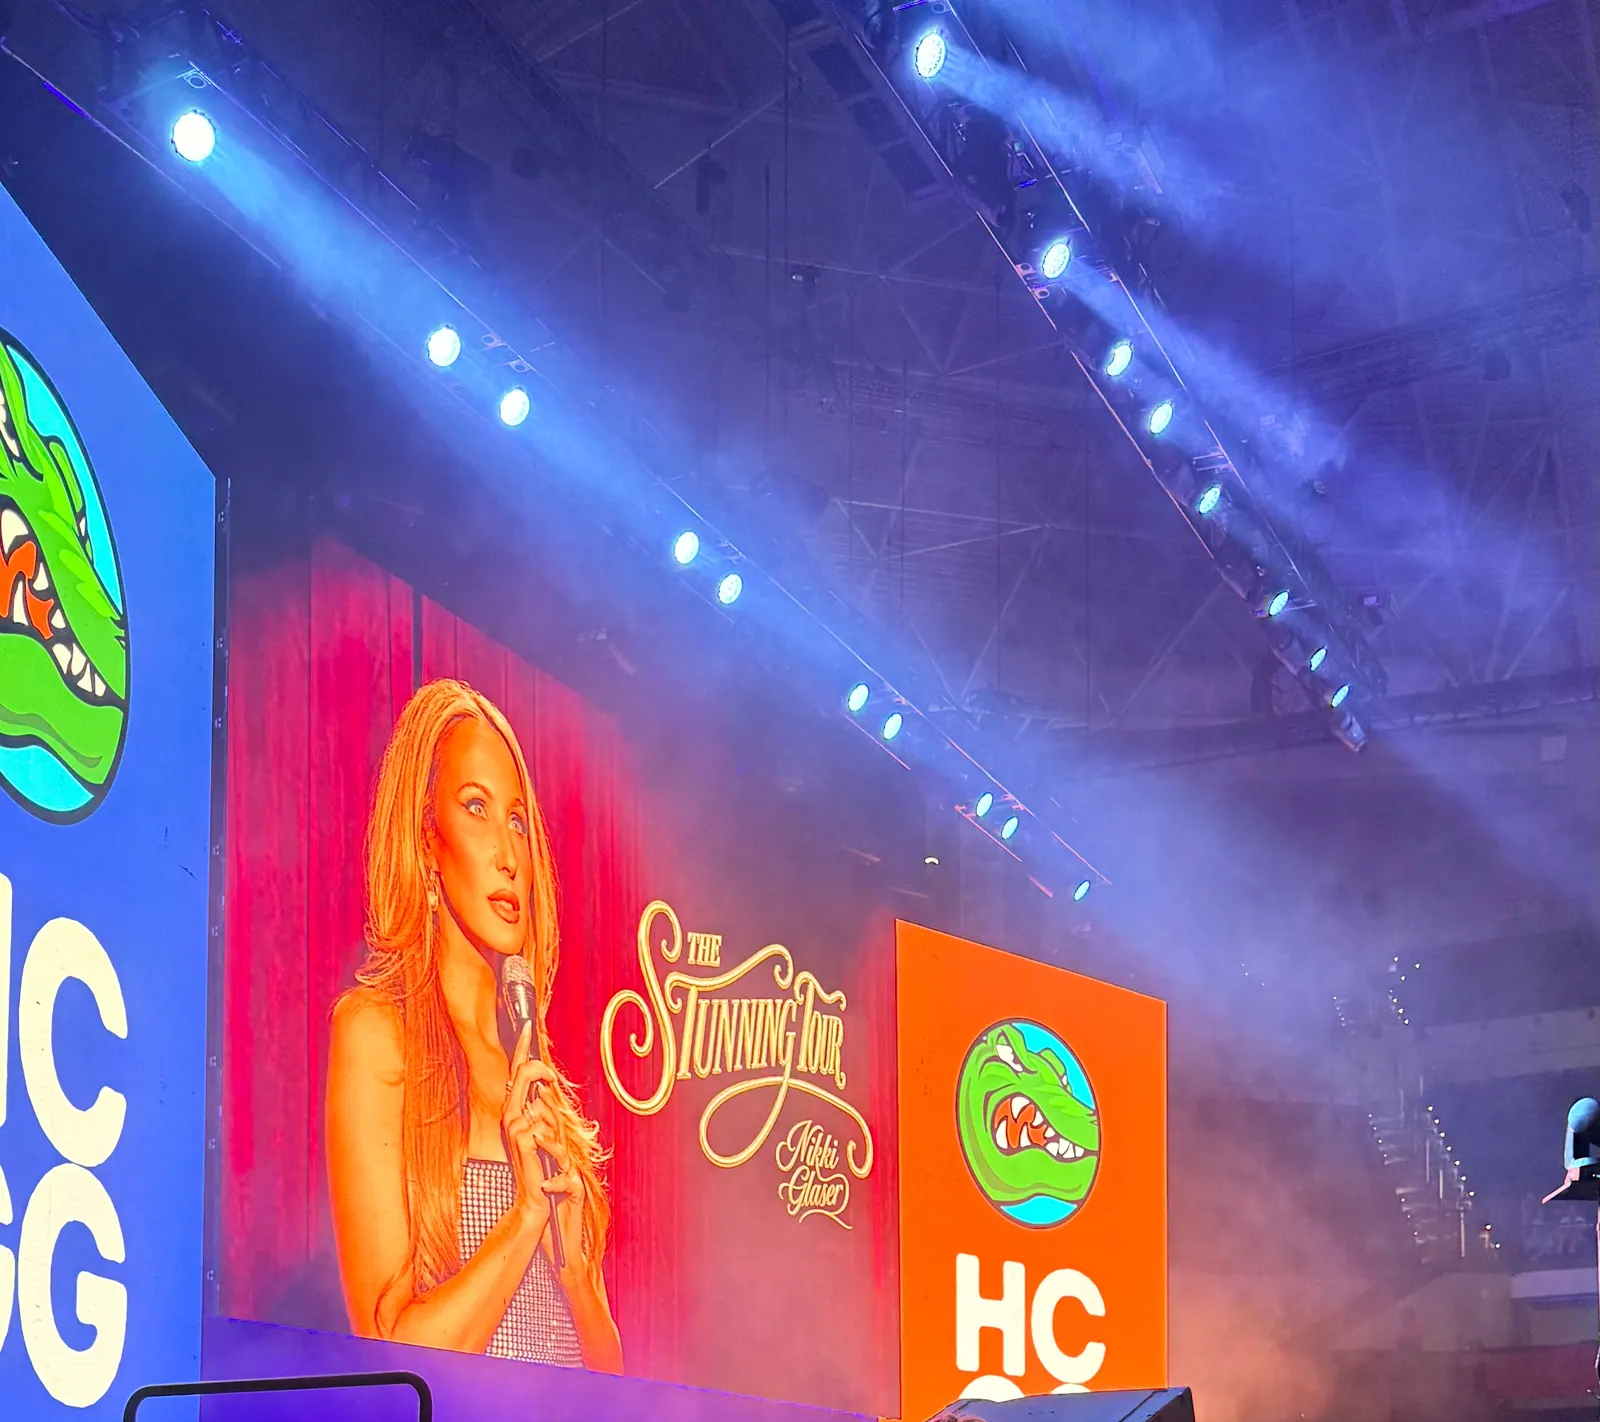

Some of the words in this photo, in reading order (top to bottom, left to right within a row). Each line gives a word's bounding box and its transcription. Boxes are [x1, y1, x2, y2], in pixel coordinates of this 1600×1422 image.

[687, 931, 722, 968] THE
[0, 872, 128, 1167] C
[795, 971, 846, 1090] TOUR
[775, 1120, 840, 1172] Nikki
[778, 1165, 844, 1217] Glaser
[0, 1162, 128, 1409] G
[955, 1252, 1107, 1384] HC
